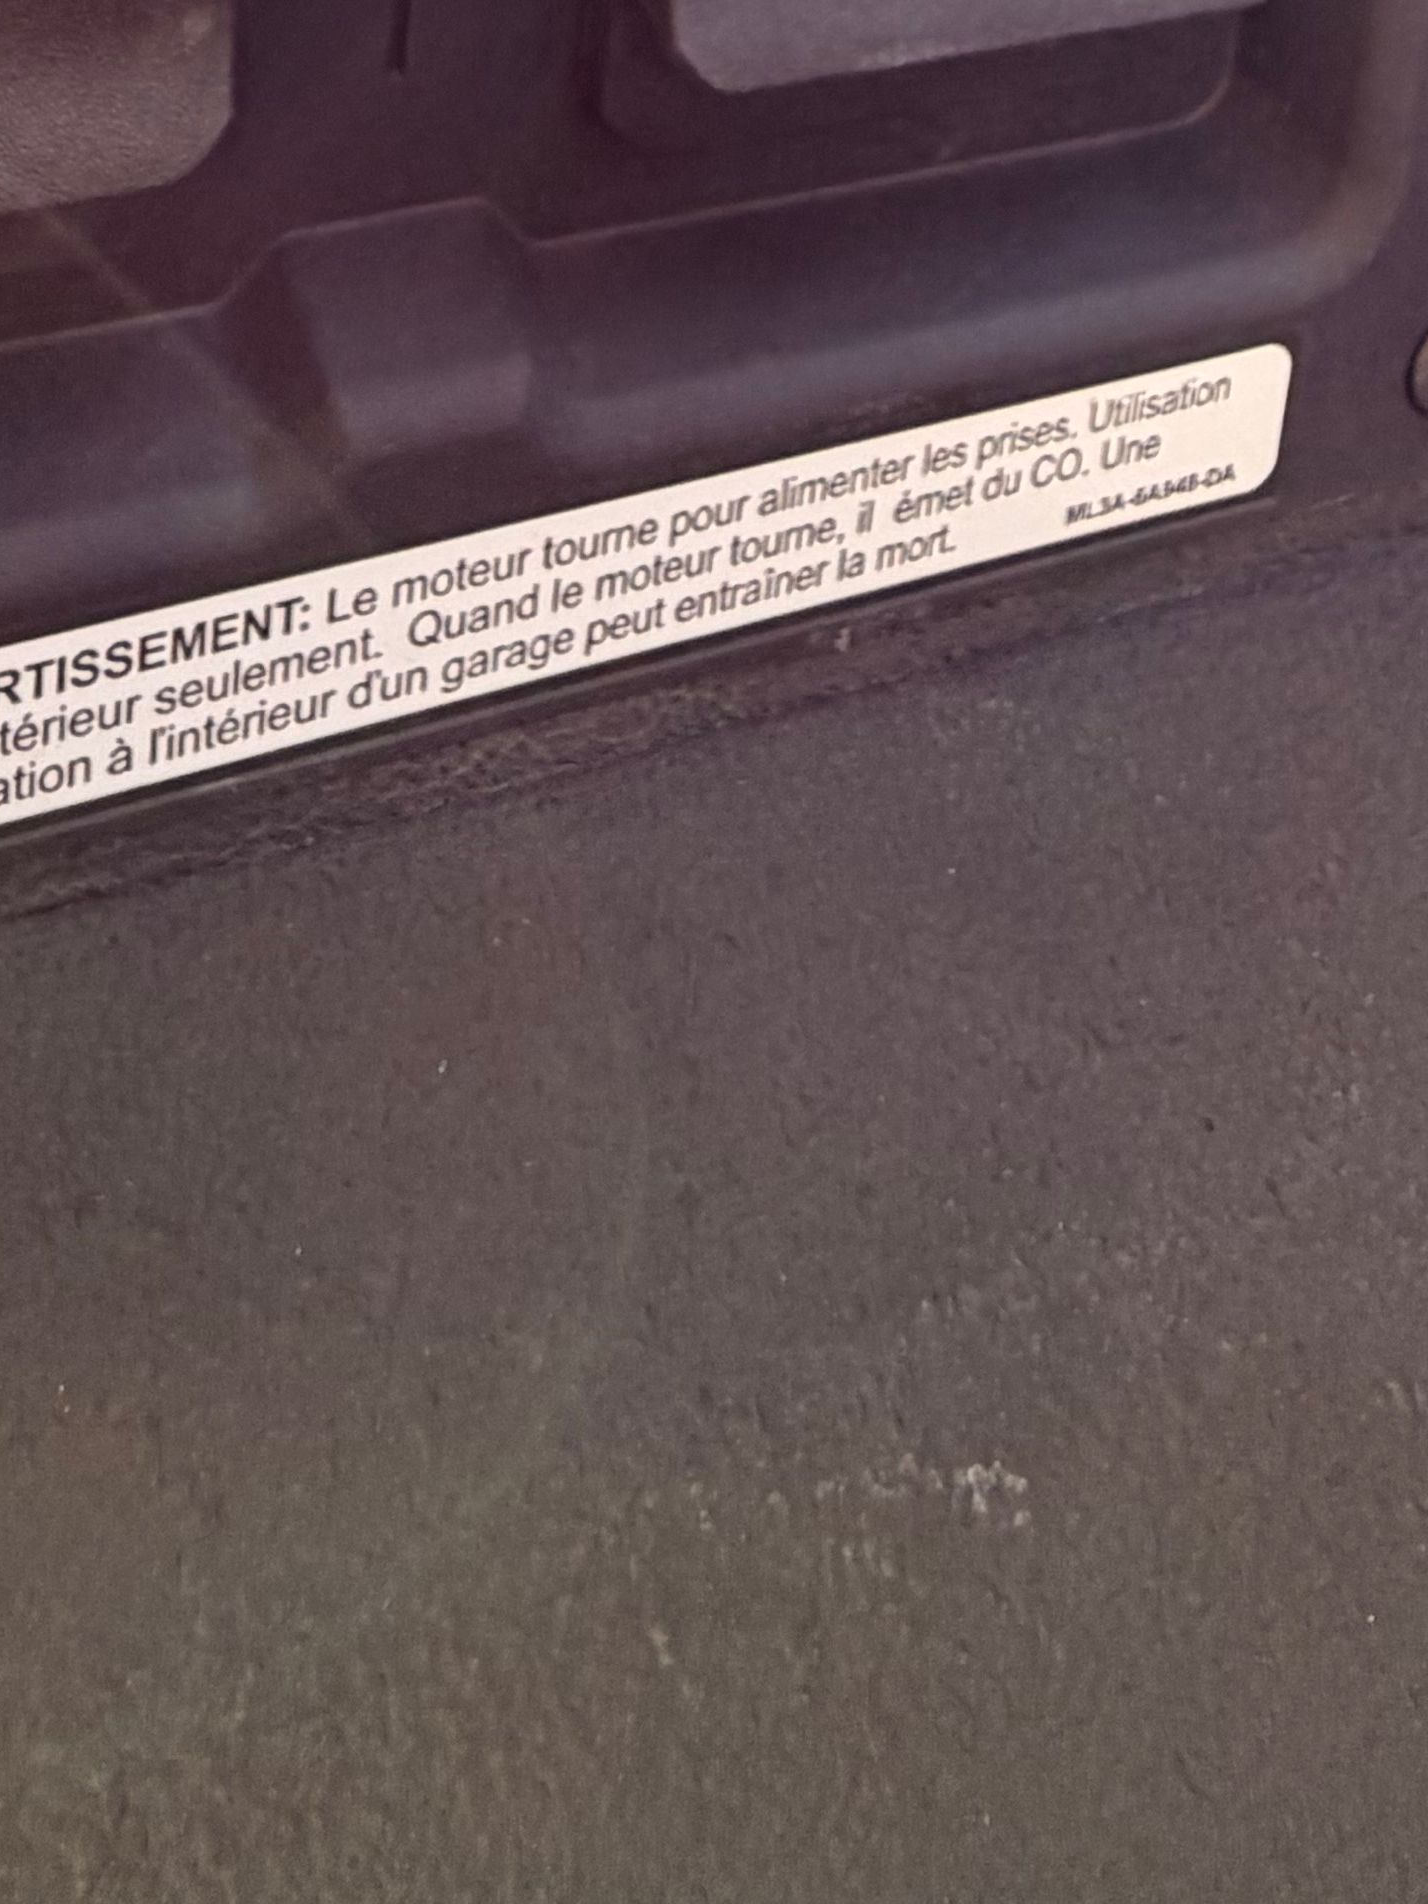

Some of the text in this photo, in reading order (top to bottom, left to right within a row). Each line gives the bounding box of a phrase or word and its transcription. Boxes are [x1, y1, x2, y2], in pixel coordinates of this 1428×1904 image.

[153, 629, 384, 716] seulement.
[408, 584, 540, 650] Quand
[552, 572, 583, 613] le
[595, 543, 716, 599] moteur
[728, 507, 847, 570] tourne,
[855, 498, 875, 535] il
[892, 478, 975, 522] émet
[981, 467, 1023, 502] du
[1030, 448, 1091, 490] CO.
[1100, 431, 1162, 472] Une
[326, 587, 377, 625] Le
[391, 543, 531, 610] moteur
[542, 515, 658, 571] tourne
[669, 498, 749, 557] pour
[758, 453, 915, 518] alimenter
[922, 439, 969, 480] les
[975, 417, 1079, 473] prises.
[1088, 374, 1233, 436] Utilisation
[106, 735, 134, 776] à
[149, 691, 339, 766] l'intérieur
[348, 667, 429, 711] d'un
[440, 629, 574, 694] garage
[584, 597, 667, 656] peut
[837, 540, 866, 580] la
[874, 524, 956, 574] mort.
